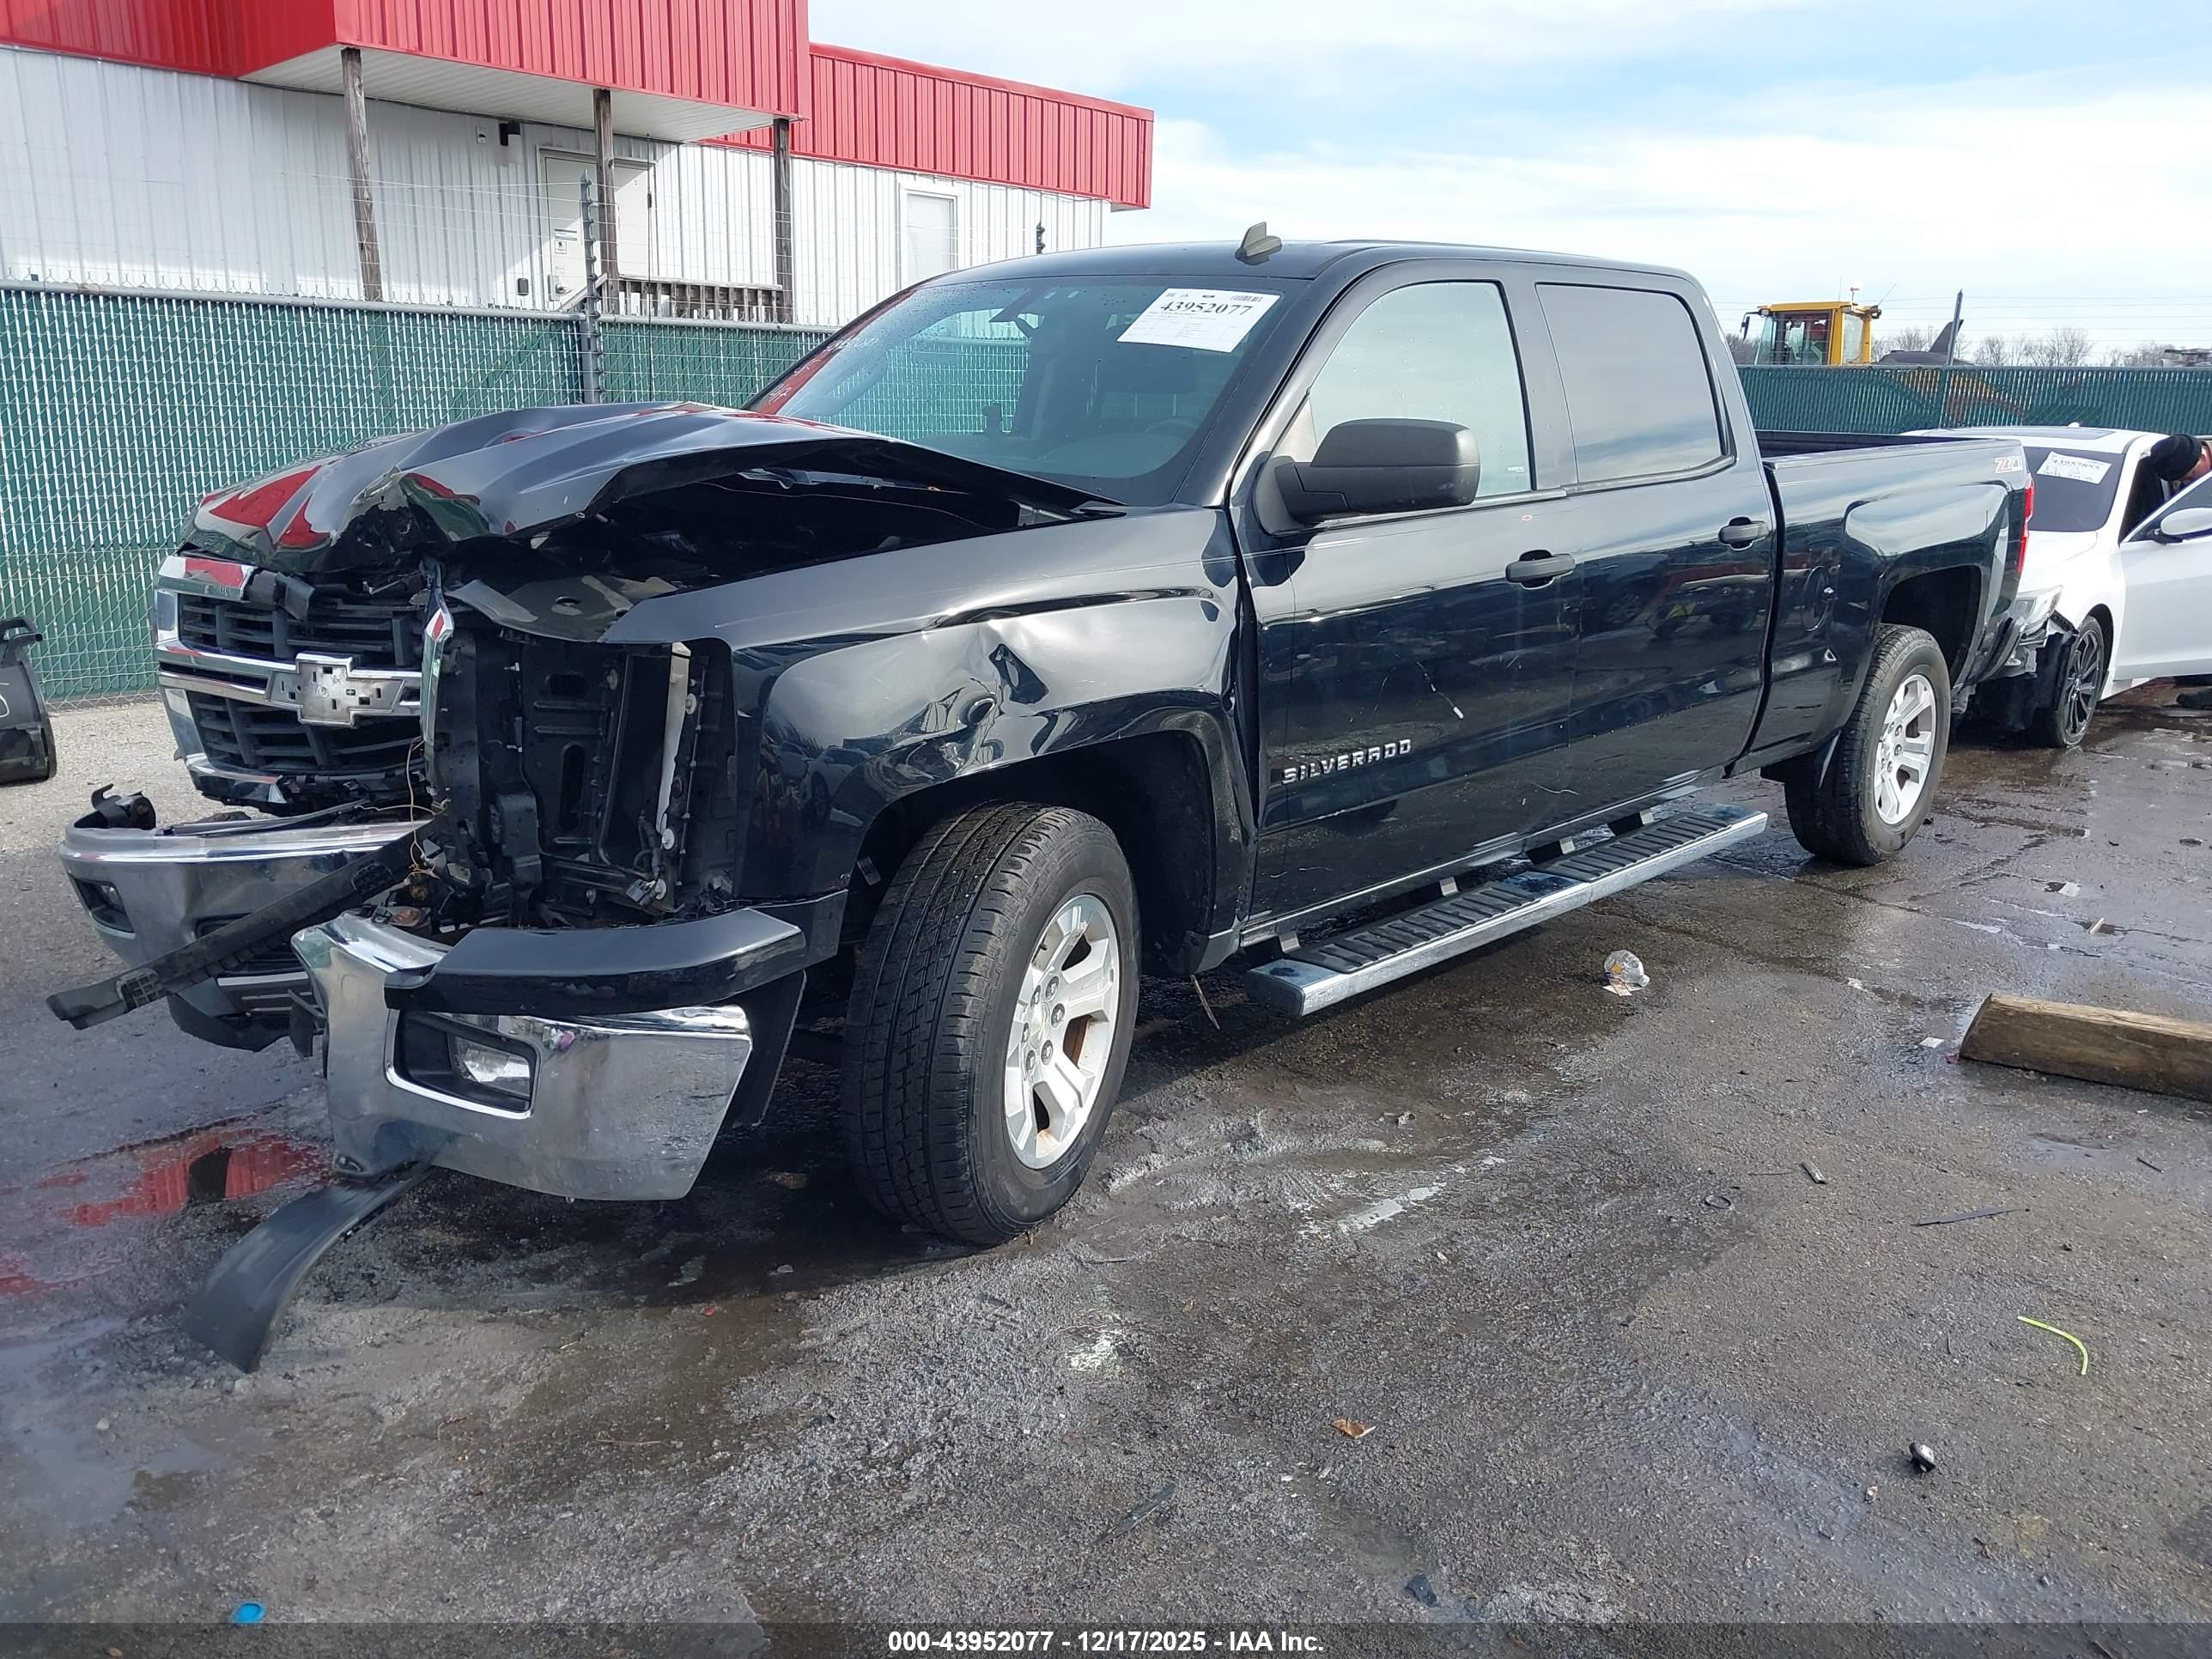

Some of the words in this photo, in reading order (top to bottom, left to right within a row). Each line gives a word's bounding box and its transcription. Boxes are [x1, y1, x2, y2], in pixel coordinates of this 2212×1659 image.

[1160, 301, 1253, 316] 43952077
[1994, 455, 2024, 474] Z71
[1281, 738, 1412, 785] SILVERADO
